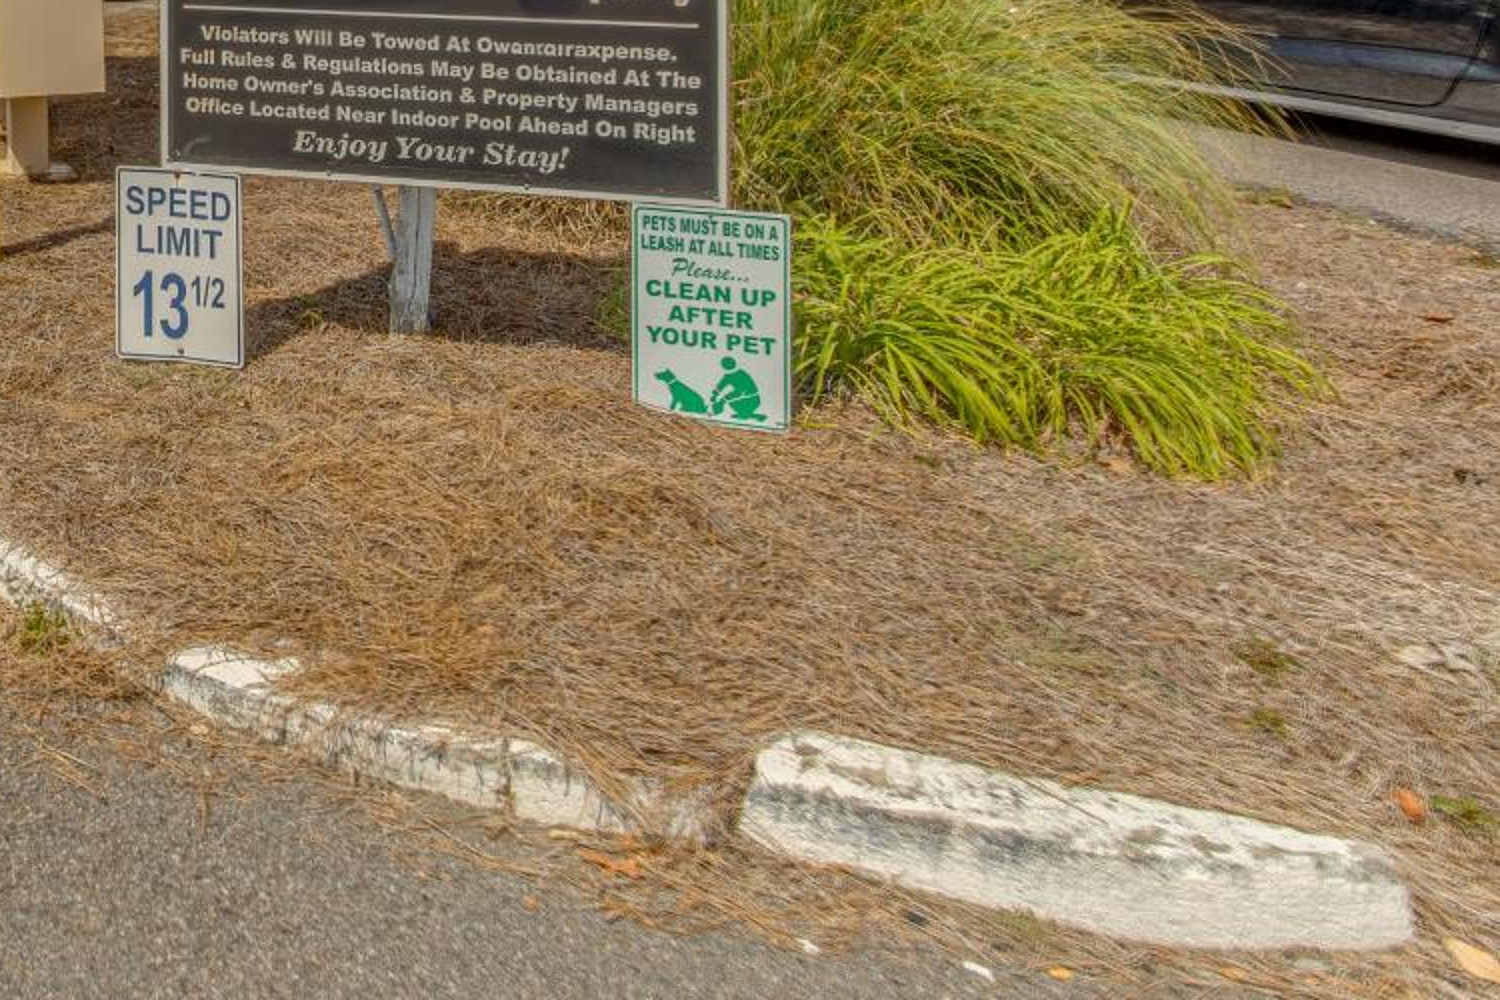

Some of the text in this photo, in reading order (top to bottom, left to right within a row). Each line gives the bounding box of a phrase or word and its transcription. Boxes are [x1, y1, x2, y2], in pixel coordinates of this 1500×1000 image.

[200, 24, 290, 46] Violators
[295, 29, 333, 47] Will
[339, 31, 366, 48] Be
[372, 31, 440, 52] Towed
[446, 36, 471, 53] At
[180, 48, 702, 90] Full Rules & Regulations May Be Obtained At The
[183, 72, 700, 118] Home Owner's Association & Property Managers
[185, 97, 697, 146] Office Located Near Indoor Pool Ahead On Right
[293, 130, 571, 174] Enjoy Your Stay!
[125, 186, 231, 221] SPEED
[137, 224, 223, 259] LIMIT
[642, 215, 779, 241] PETS MUST BE ON A
[640, 235, 780, 261] LEASH AT ALL TIMES
[645, 279, 776, 308] CLEAN UP
[668, 305, 753, 330] AFTER
[646, 325, 776, 356] YOUR PET
